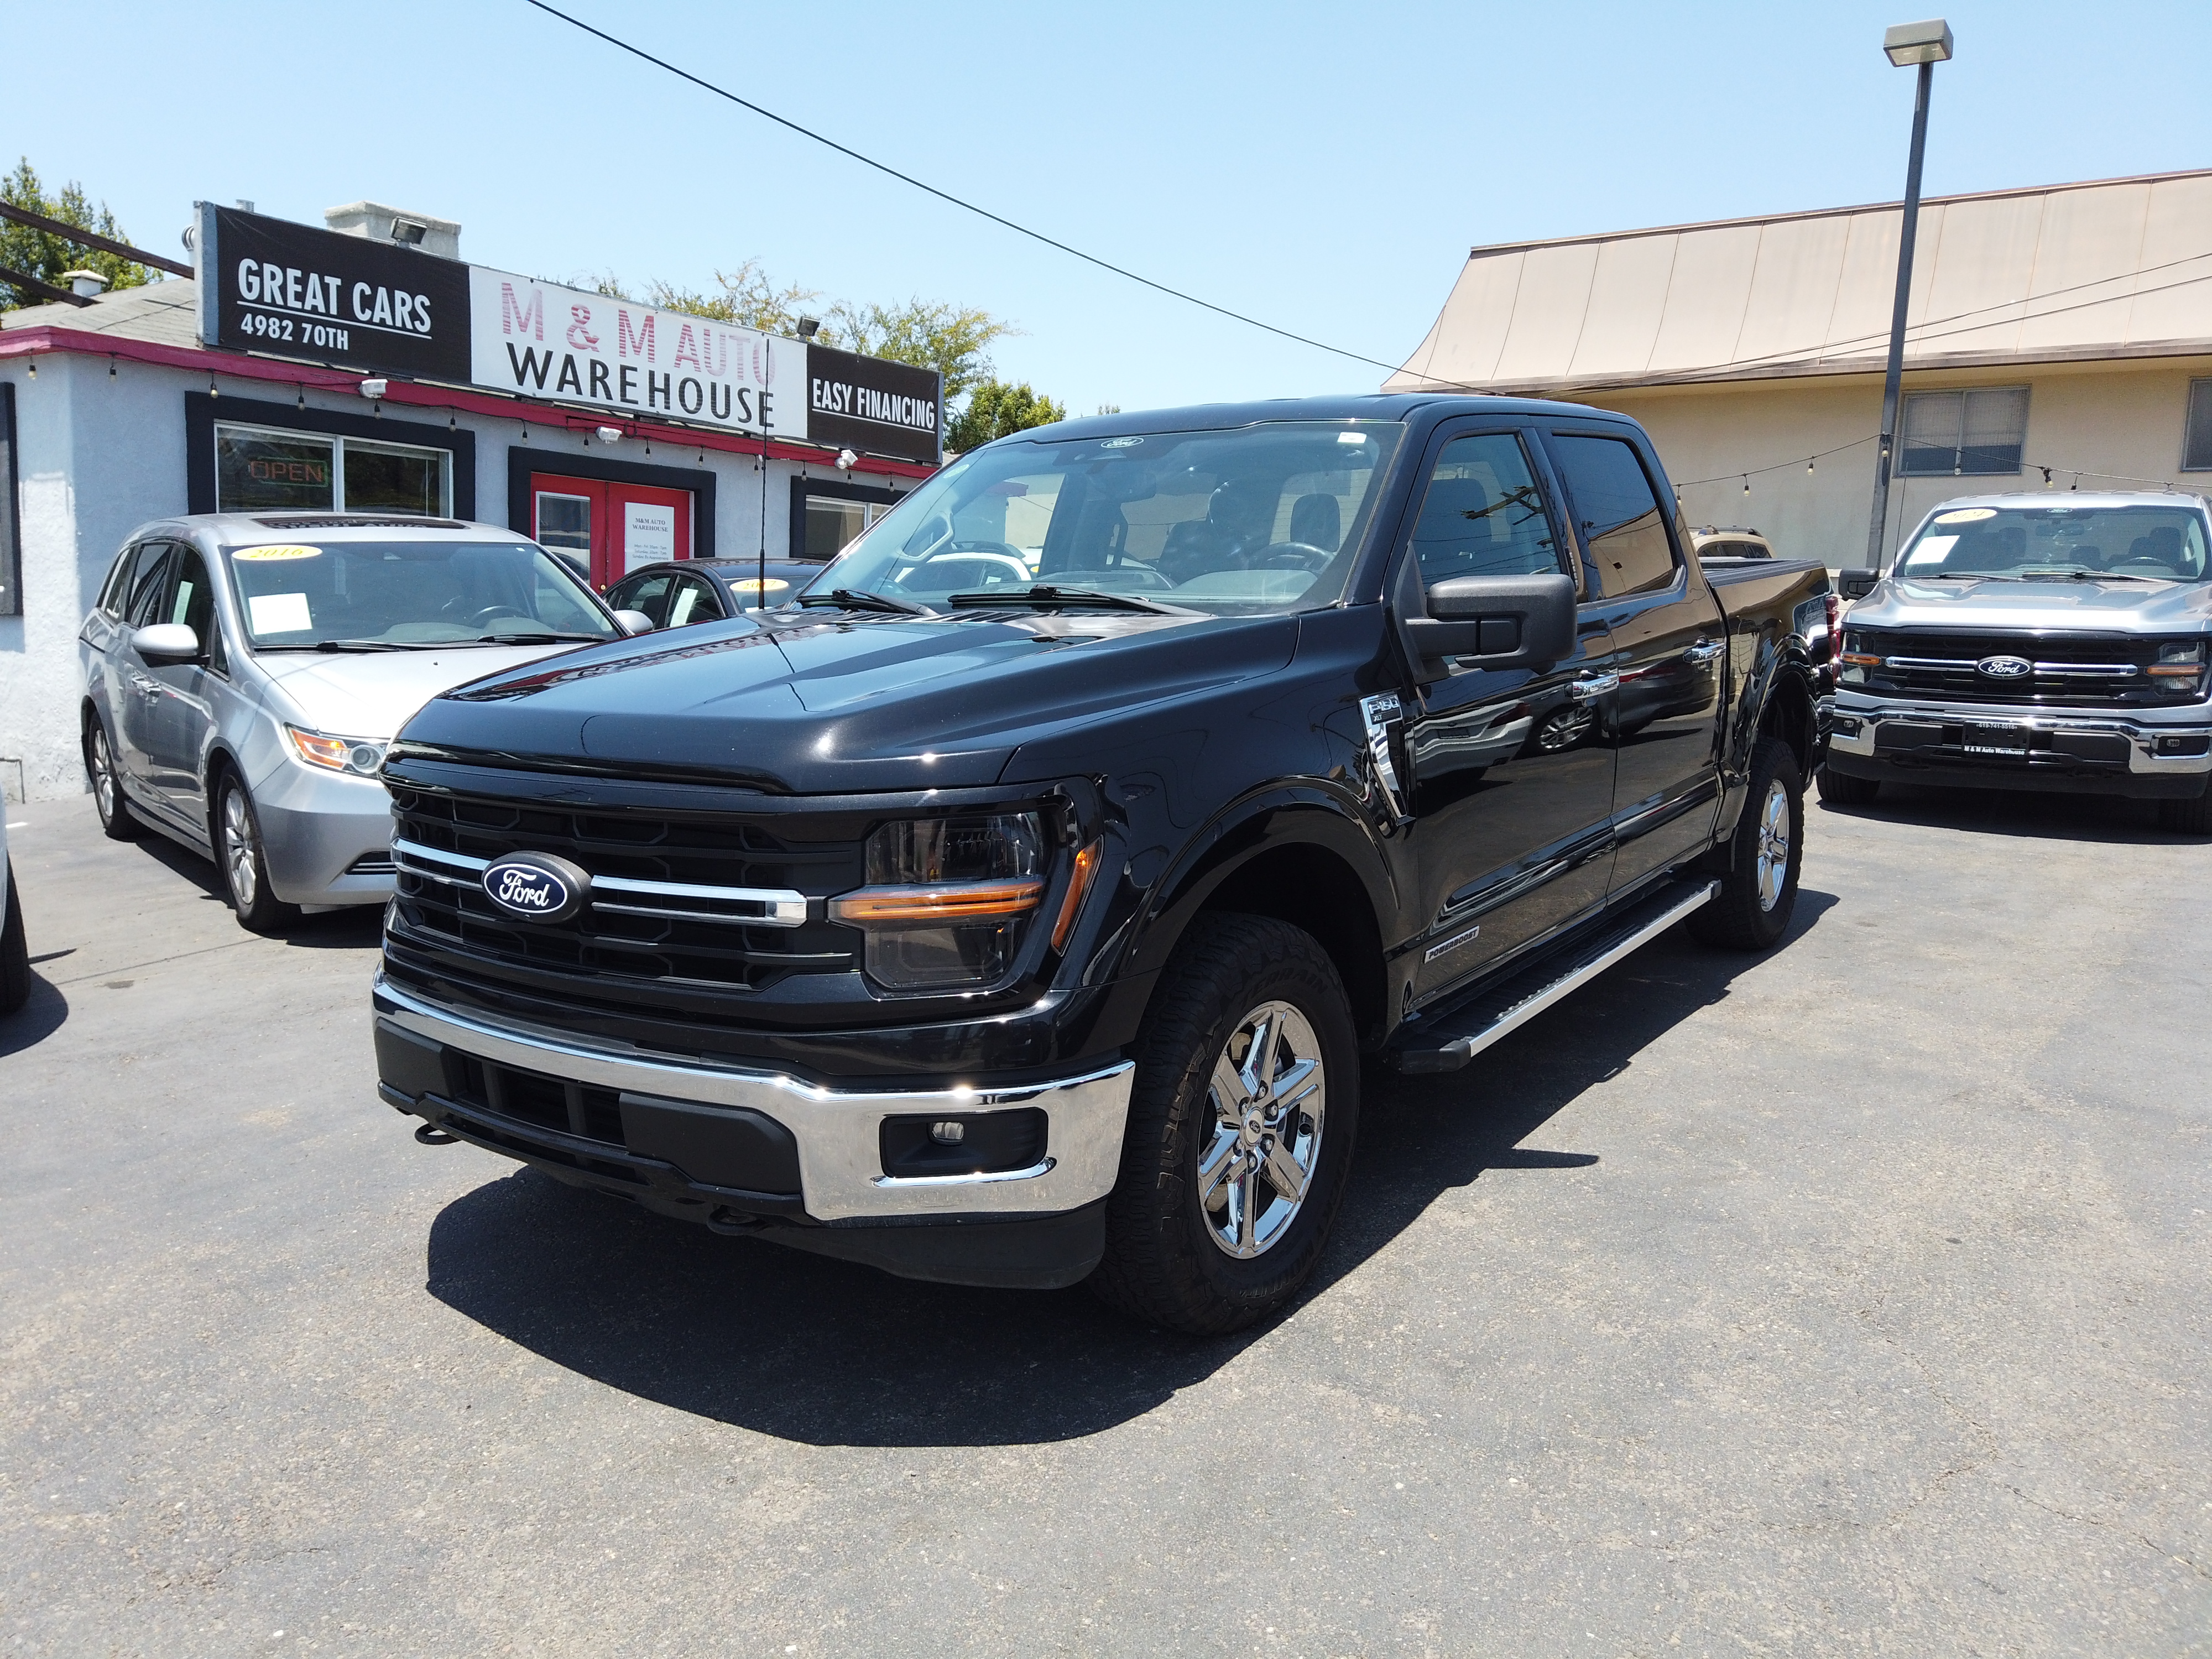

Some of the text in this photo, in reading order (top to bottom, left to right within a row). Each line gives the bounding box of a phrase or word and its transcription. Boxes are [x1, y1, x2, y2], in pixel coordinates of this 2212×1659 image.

[238, 258, 431, 333] GREAT CARS
[240, 313, 349, 351] 4982 70TH
[501, 282, 776, 387] M & M AUTO
[505, 341, 775, 428] WAREHOUSE
[812, 378, 935, 429] EASY FINANCING
[250, 460, 323, 483] OPEN
[632, 524, 668, 532] WAREHOUSE
[249, 548, 304, 558] 2016
[1987, 661, 2021, 674] Ford
[499, 869, 550, 907] Ford
[1428, 929, 1478, 959] POWERBOOST
[1250, 1121, 1260, 1133] Ford
